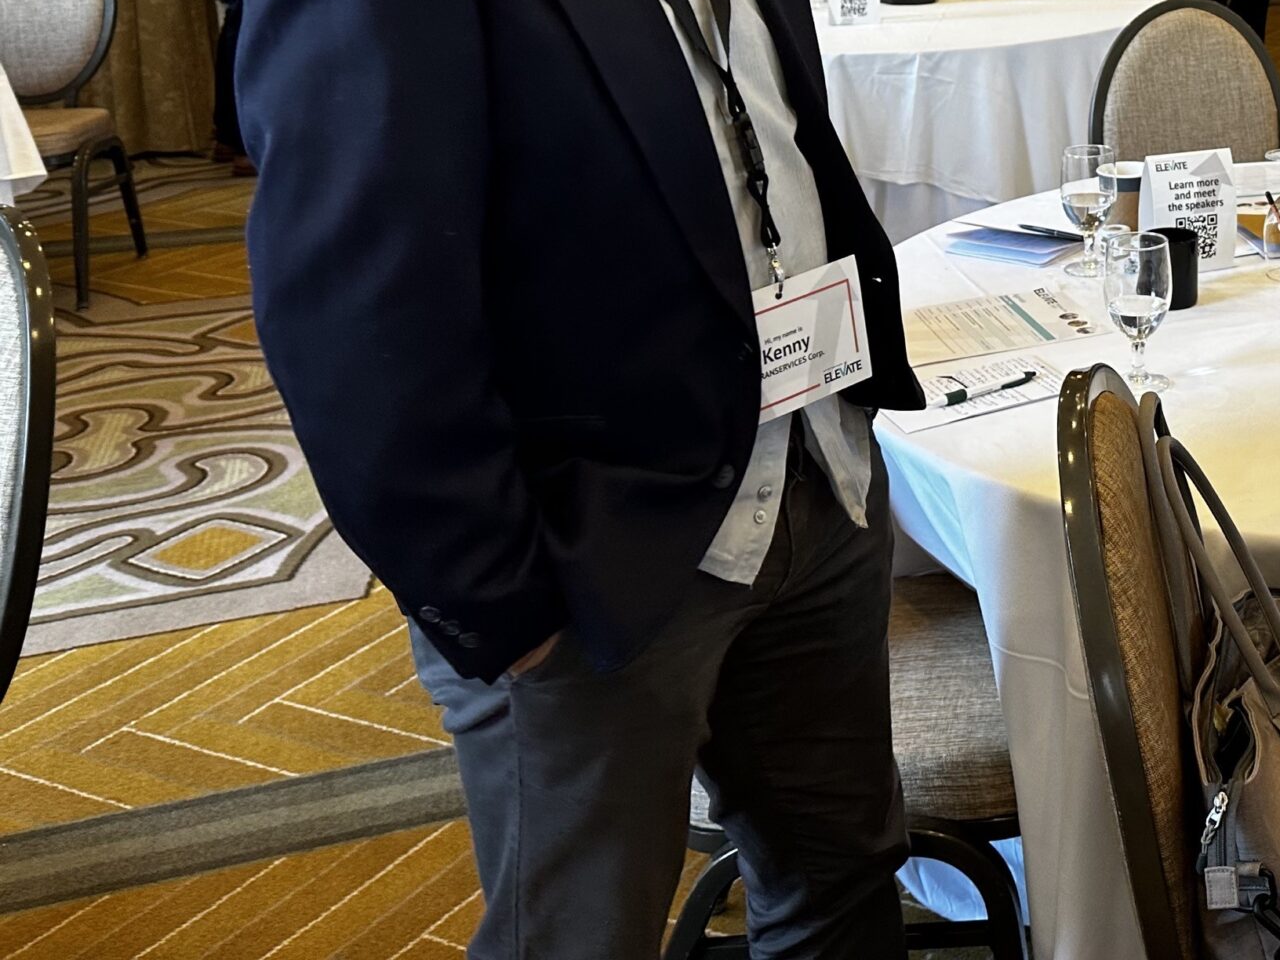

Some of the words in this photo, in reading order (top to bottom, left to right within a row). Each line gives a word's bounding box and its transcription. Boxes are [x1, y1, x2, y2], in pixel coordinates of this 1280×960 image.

[1155, 160, 1188, 172] ELEVATE
[1168, 181, 1194, 191] Learn
[1196, 178, 1220, 187] more
[1174, 190, 1191, 200] and
[1193, 189, 1217, 198] meet
[1168, 202, 1183, 212] the
[1185, 199, 1224, 211] speakers
[762, 335, 810, 365] Kenny
[808, 350, 825, 361] Corp.
[823, 360, 863, 384] ELEVATE
